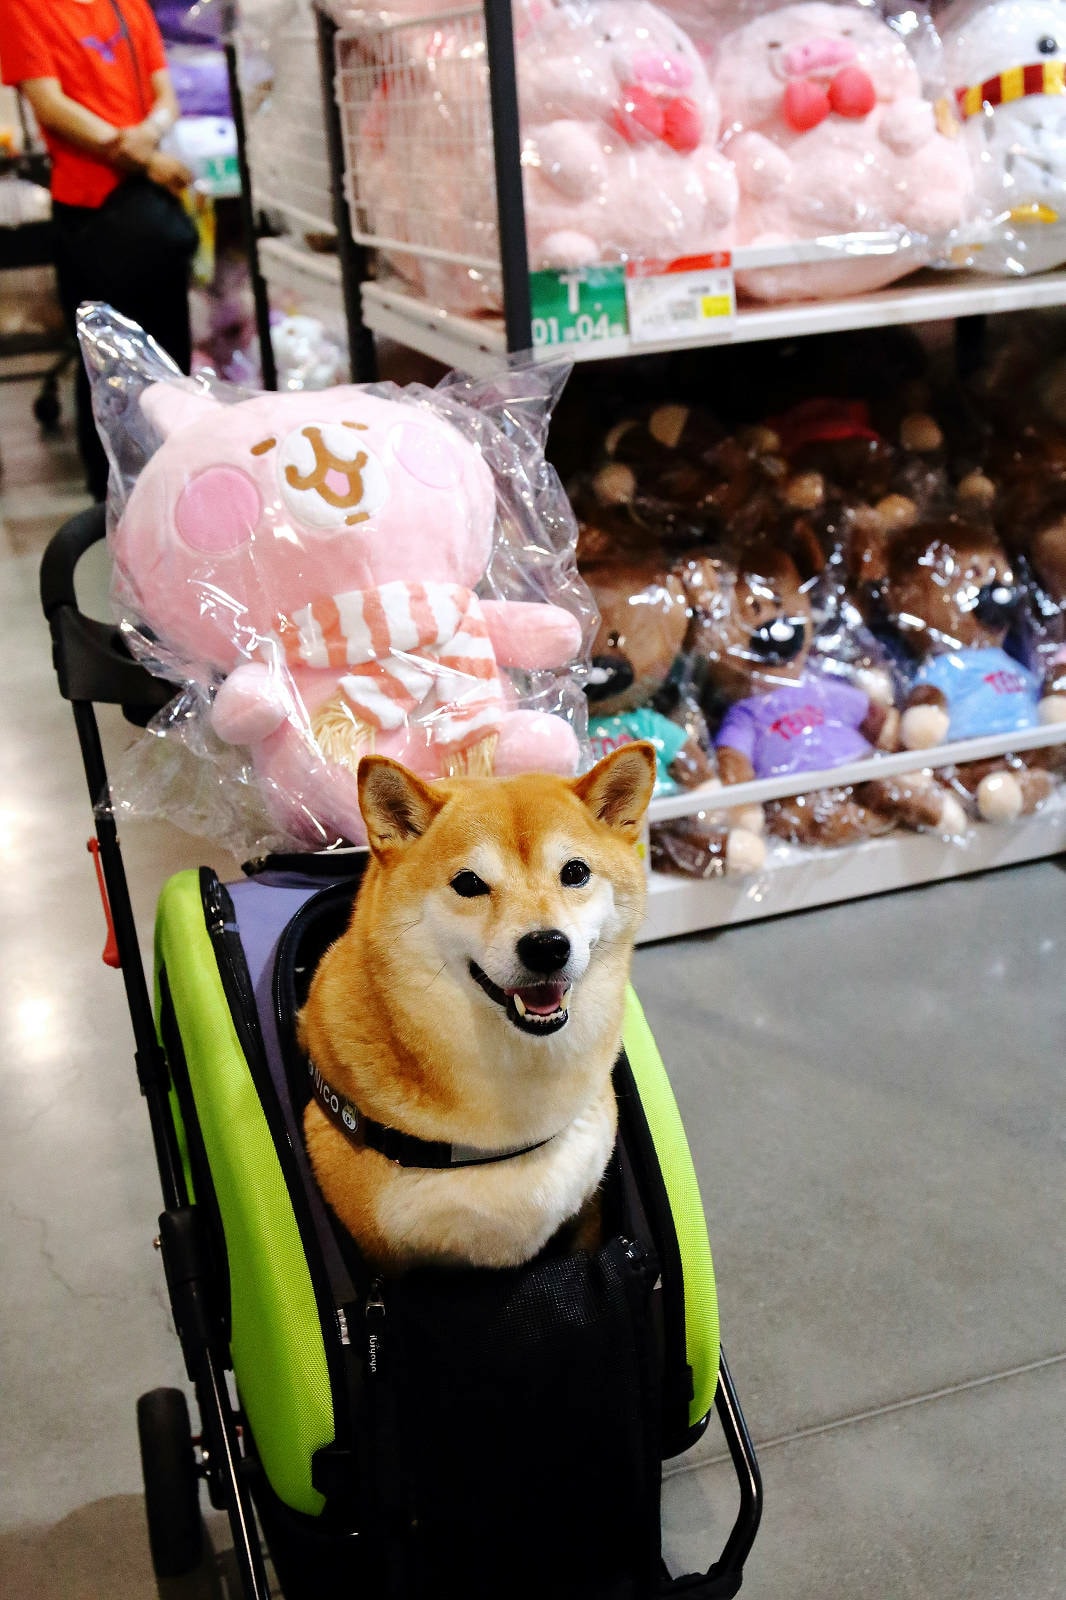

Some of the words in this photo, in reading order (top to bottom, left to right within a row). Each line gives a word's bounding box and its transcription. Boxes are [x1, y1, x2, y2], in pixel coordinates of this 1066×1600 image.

[559, 273, 587, 314] T
[531, 317, 560, 345] 01
[576, 314, 609, 342] 04
[314, 1066, 339, 1113] NICO
